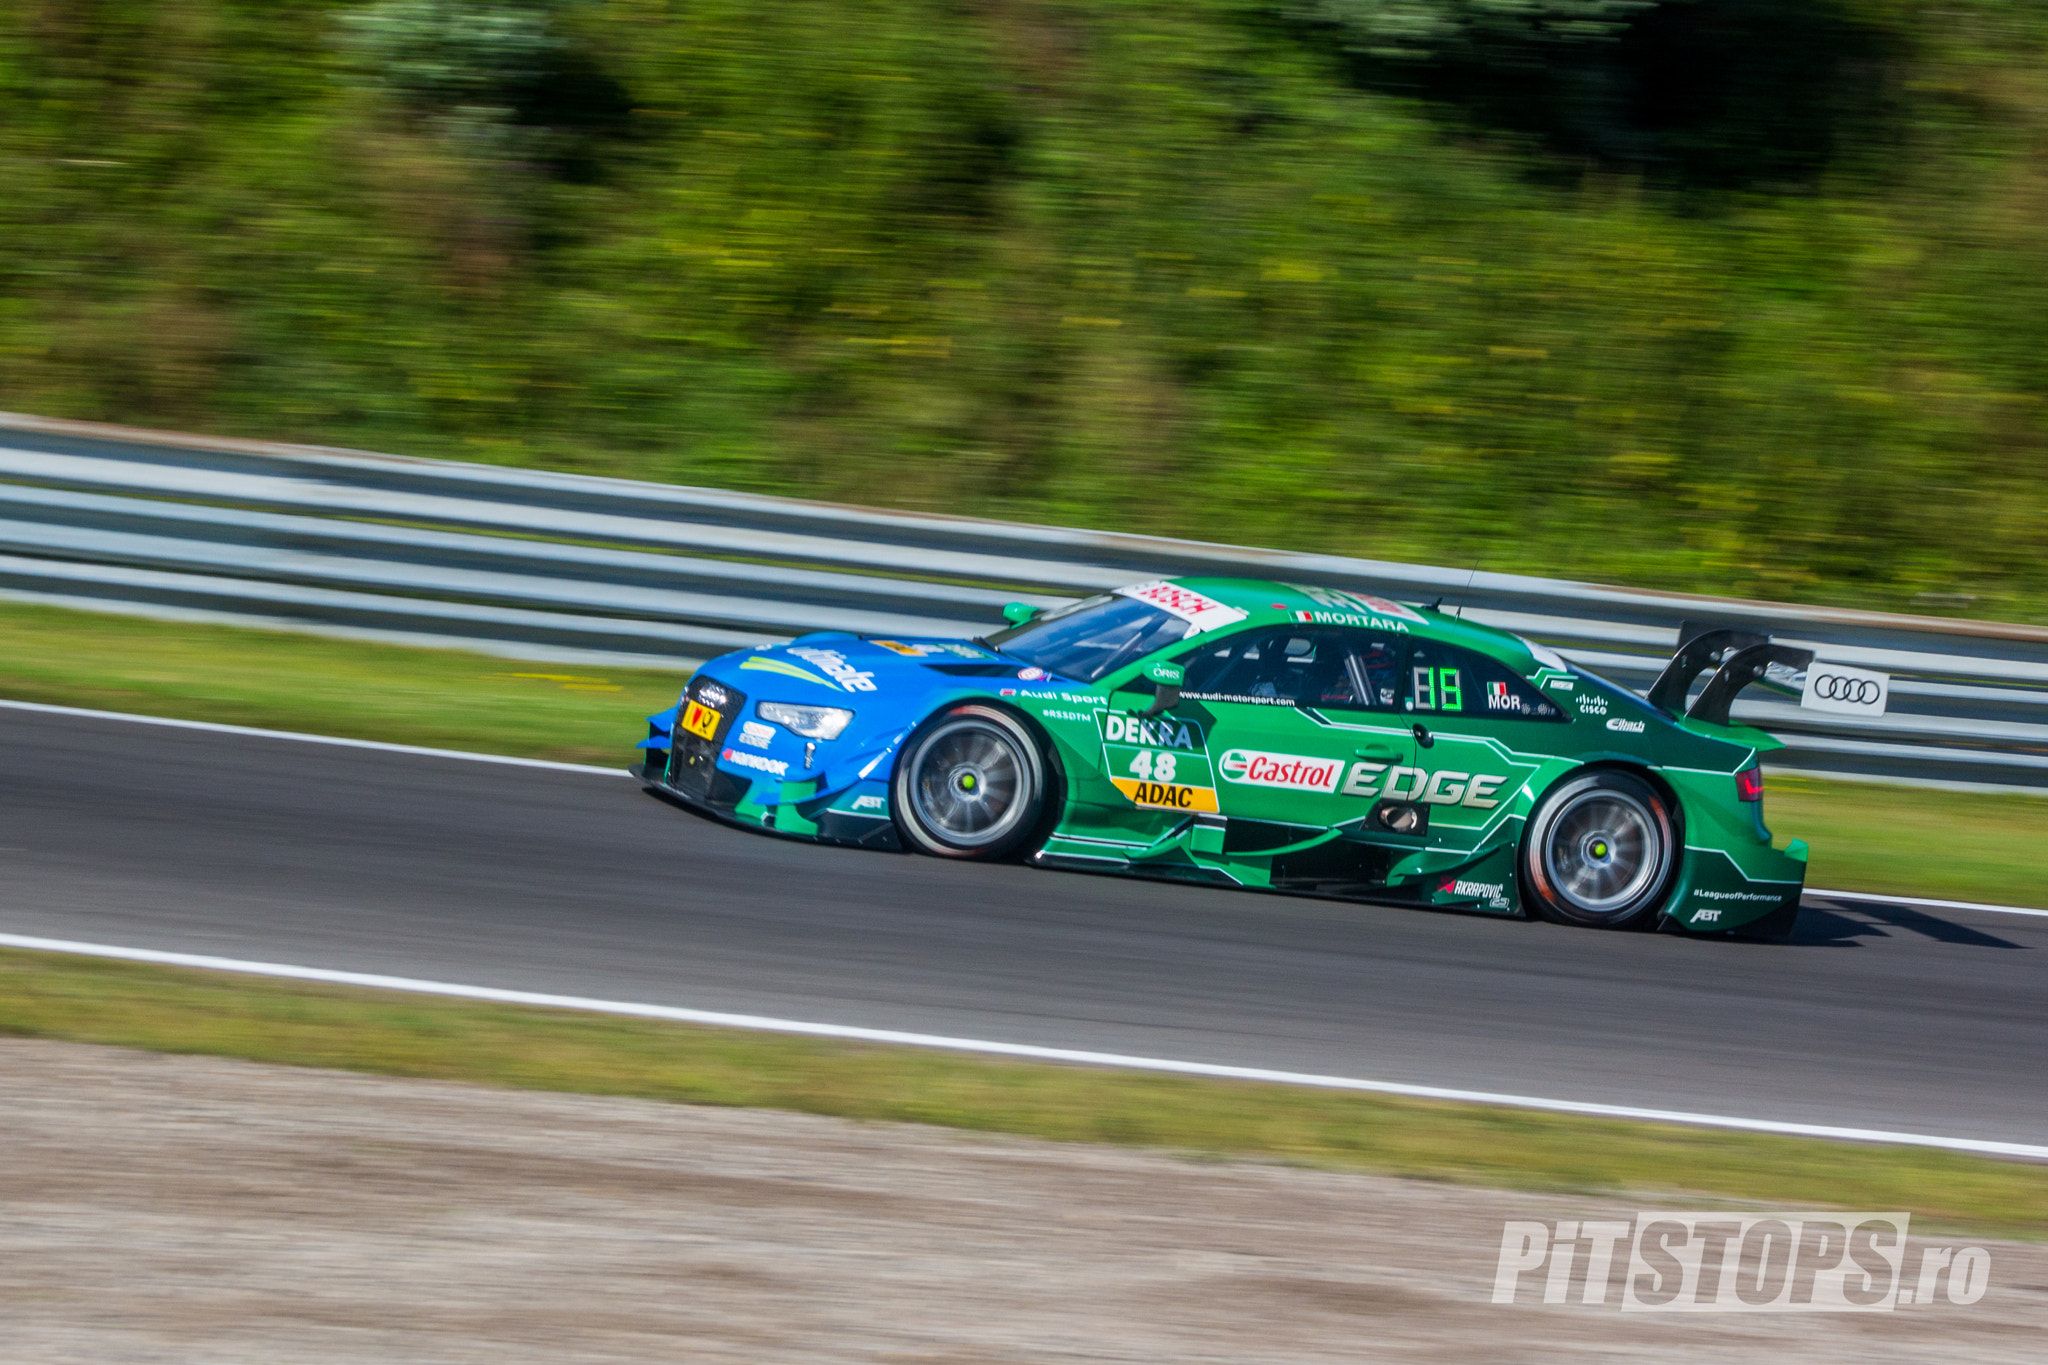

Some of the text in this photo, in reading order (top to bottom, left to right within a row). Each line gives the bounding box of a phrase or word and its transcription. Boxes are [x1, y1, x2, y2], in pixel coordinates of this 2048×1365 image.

[1139, 585, 1217, 616] BOSCH
[1314, 610, 1410, 633] MORTARA
[1020, 689, 1058, 700] Audi
[1061, 691, 1109, 705] Sport
[1179, 690, 1296, 707] www.audi-motorsport.com
[1488, 693, 1521, 711] MOR
[1106, 714, 1193, 751] DEKRA
[1129, 749, 1177, 783] 48
[1247, 756, 1510, 809] Castrol EDGE
[851, 794, 886, 810] ABT
[1133, 782, 1194, 808] ADAC
[1693, 888, 1783, 903] #LeagueofPerformance
[1689, 908, 1722, 924] ABT
